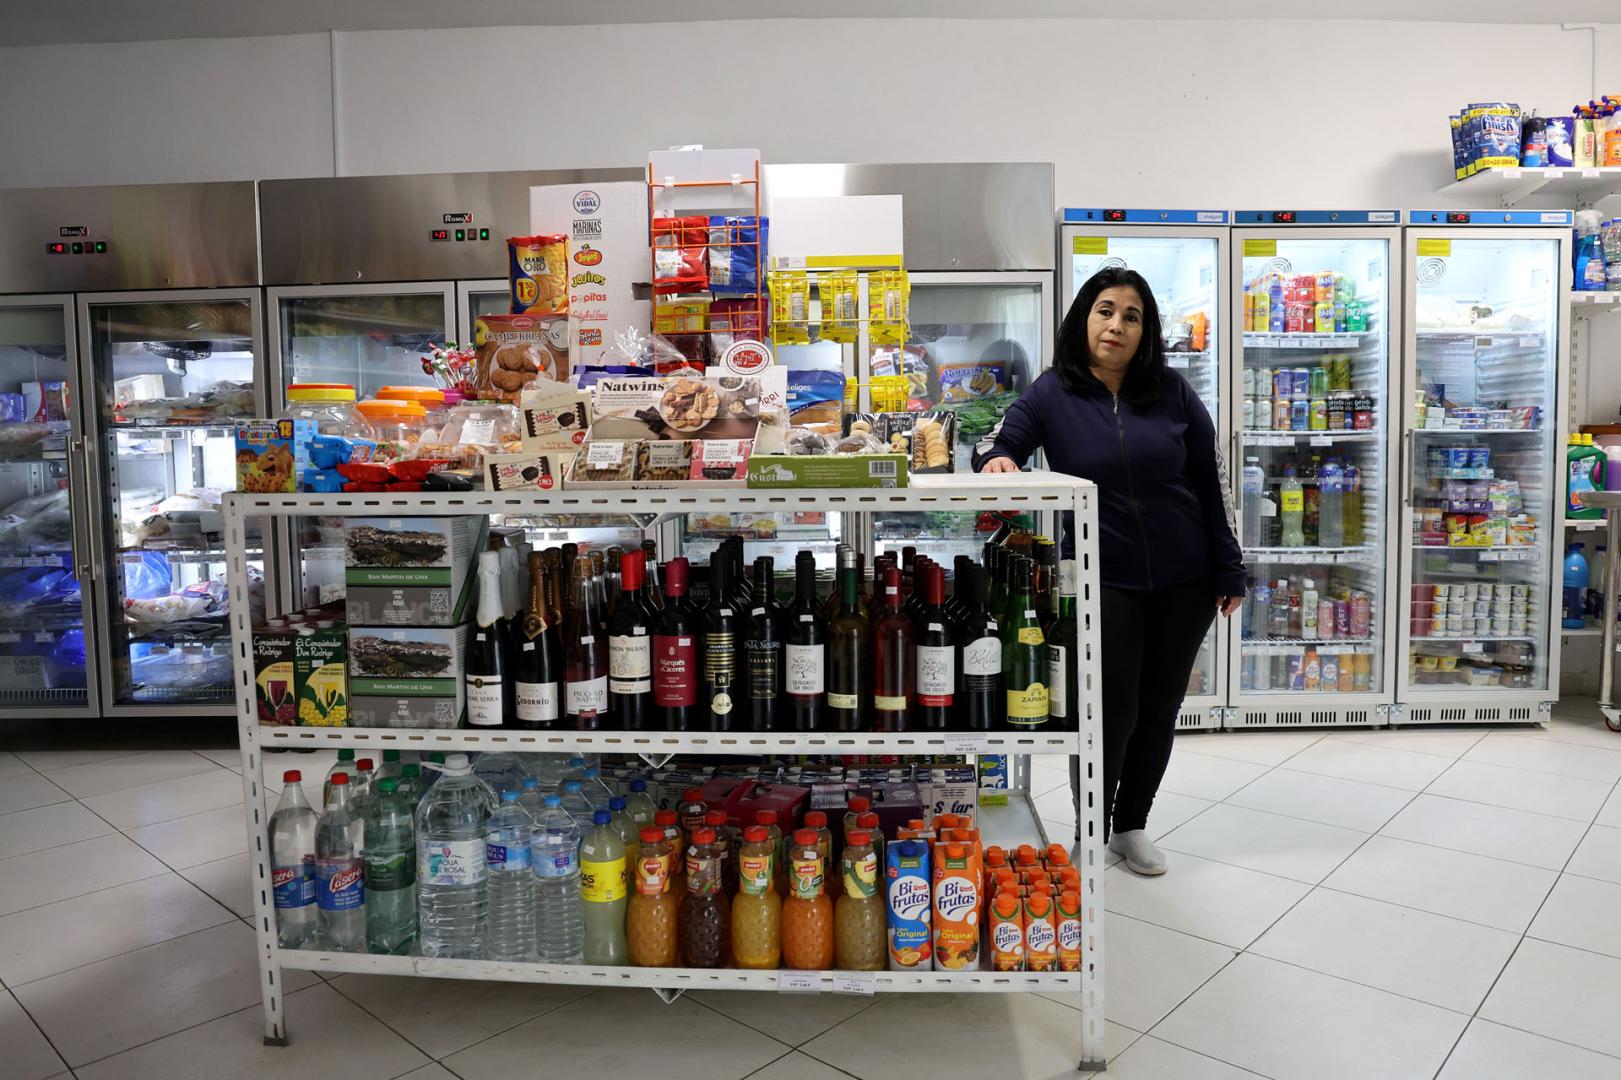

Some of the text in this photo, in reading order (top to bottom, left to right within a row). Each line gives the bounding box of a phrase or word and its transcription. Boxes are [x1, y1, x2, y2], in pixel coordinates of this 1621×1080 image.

[1482, 116, 1514, 132] finish
[576, 200, 598, 208] VIDAL
[573, 221, 602, 234] MARINAS
[524, 263, 546, 272] ORO
[485, 332, 560, 342] CAMPURRIANAS
[602, 381, 665, 392] Natwins
[254, 636, 291, 650] Conquistador
[296, 638, 341, 650] El Conquistador
[259, 646, 282, 658] Rodrigo
[297, 648, 334, 659] Don Rodrigo
[661, 660, 686, 668] Marqués
[934, 801, 973, 814] Slar
[899, 882, 913, 896] Bi
[945, 882, 958, 896] Bi
[893, 893, 928, 910] frutas
[938, 894, 974, 910] frutas
[999, 926, 1009, 935] Bi
[1033, 925, 1042, 935] Bi
[1064, 923, 1074, 933] Bi
[897, 930, 928, 940] Original
[942, 931, 973, 941] Original
[996, 934, 1020, 945] frutas
[1029, 934, 1053, 945] frutas
[1060, 932, 1081, 943] fruta
